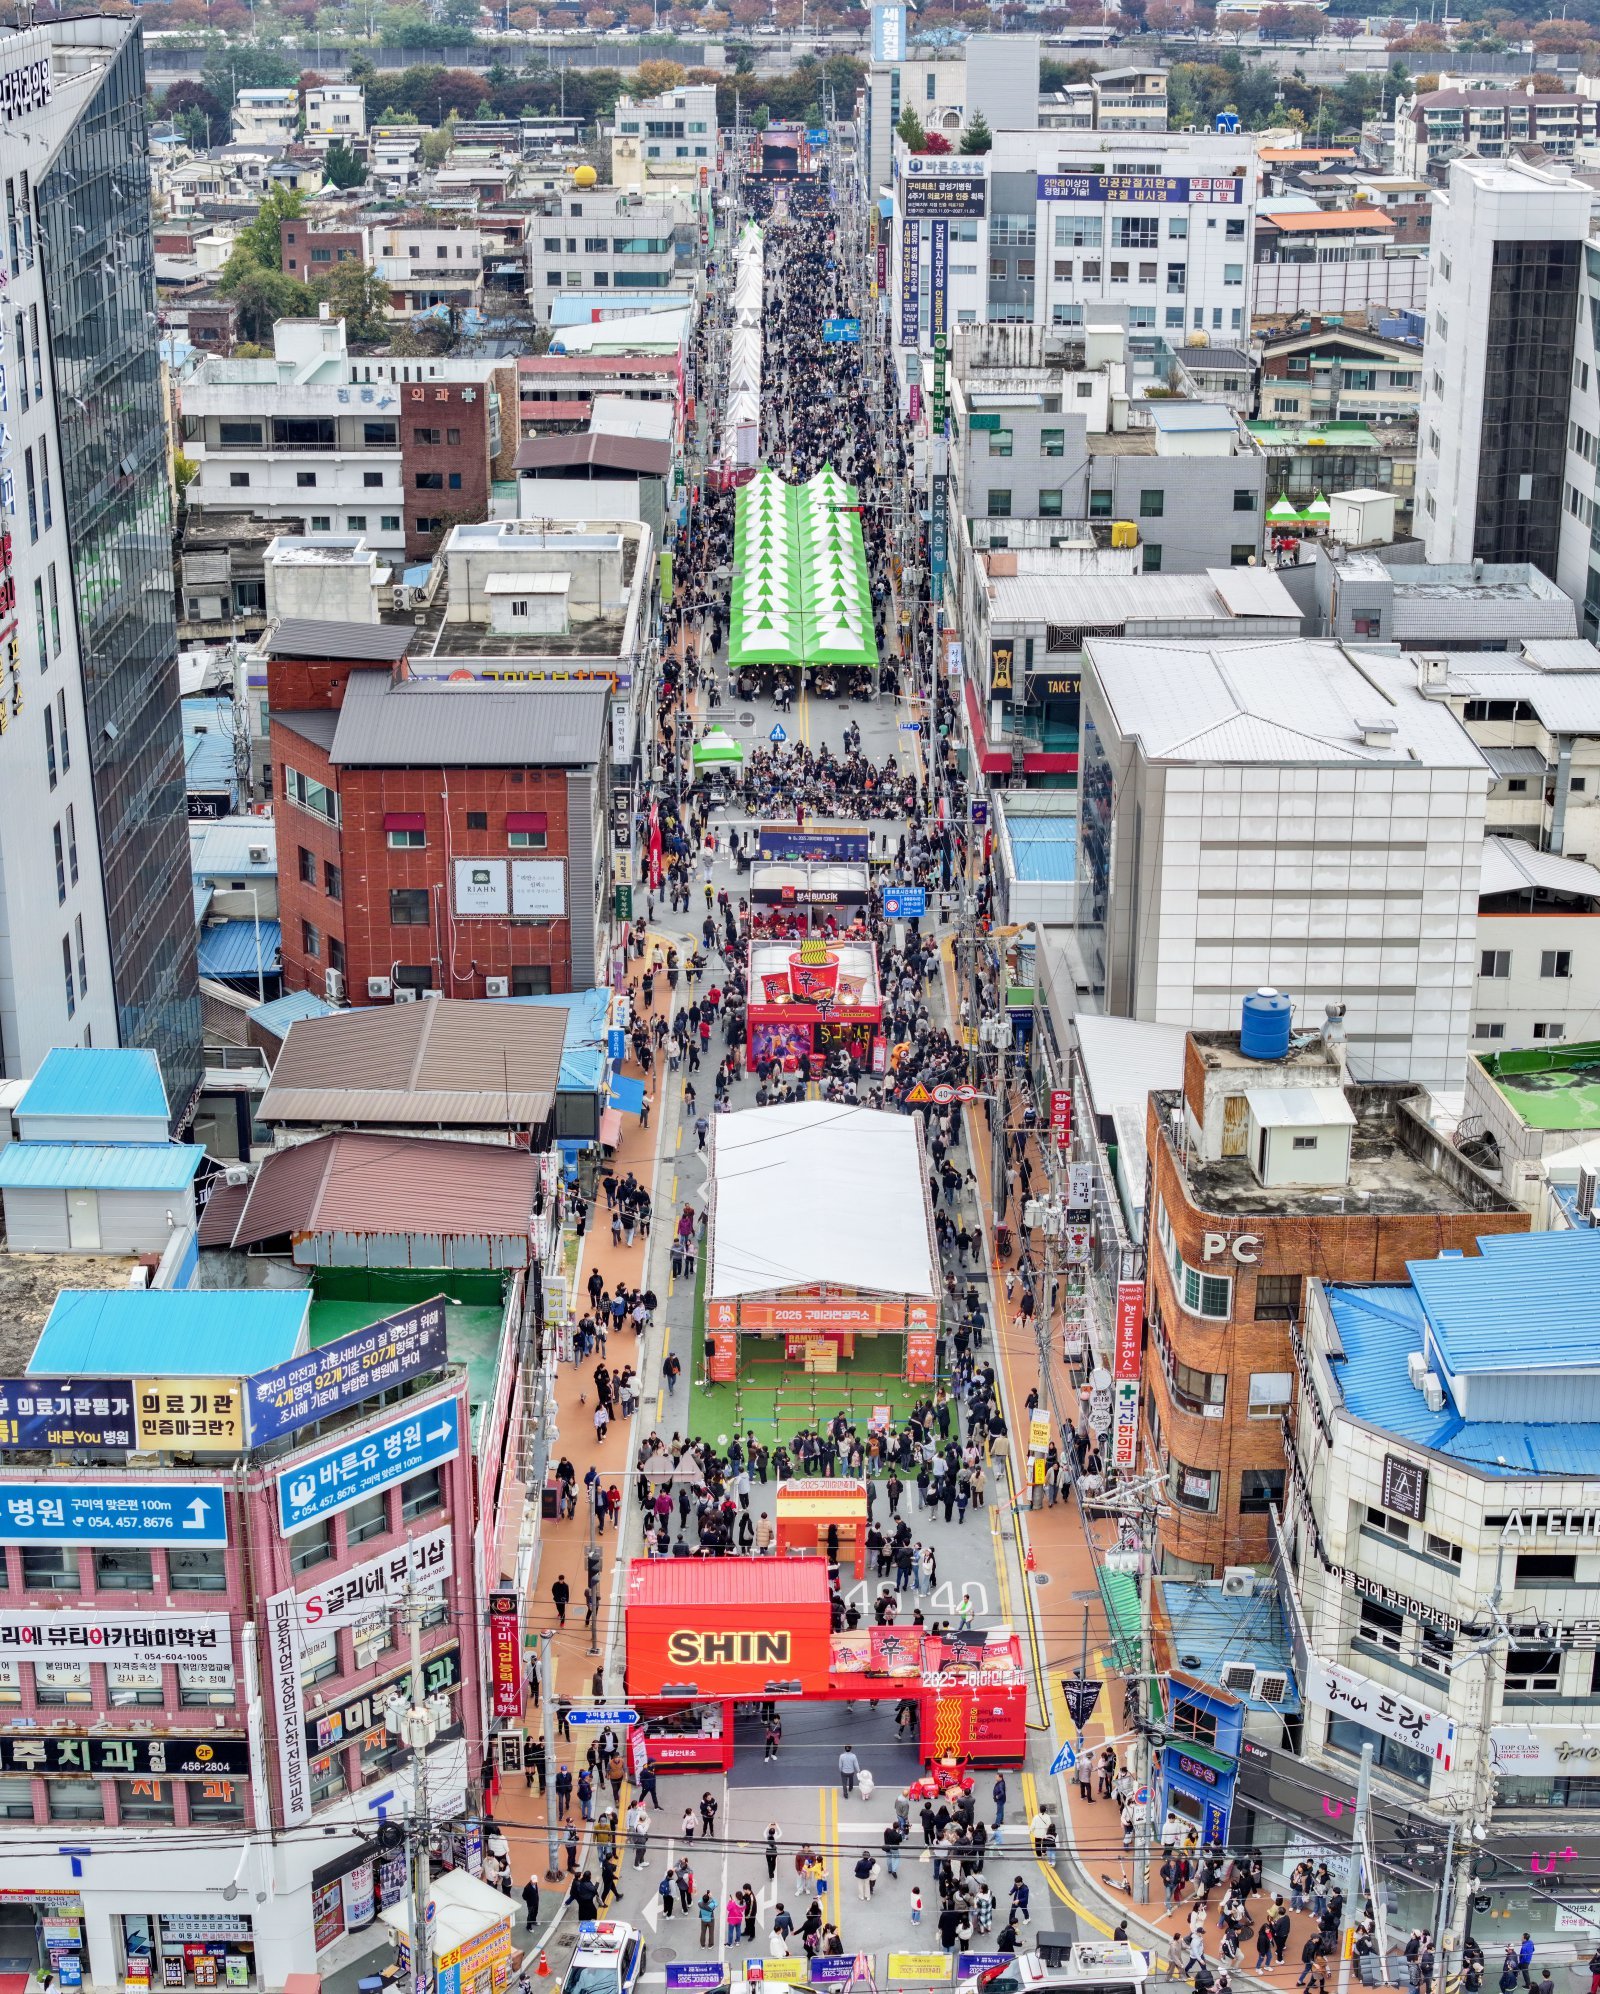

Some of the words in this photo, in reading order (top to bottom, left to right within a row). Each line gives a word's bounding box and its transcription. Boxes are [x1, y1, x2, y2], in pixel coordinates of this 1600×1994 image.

[934, 481, 945, 561] 라온저축은행
[1048, 681, 1070, 693] TAKE
[617, 795, 629, 843] 금오당
[938, 1090, 948, 1098] 40
[1204, 1233, 1259, 1263] PC
[776, 1311, 802, 1320] 2025
[1123, 1304, 1136, 1370] 핸드폰케이스
[289, 1363, 317, 1387] 안전과
[378, 1333, 388, 1348] 질
[420, 1310, 439, 1329] 위해
[280, 1402, 308, 1424] 조사해
[311, 1389, 339, 1411] 기준에
[341, 1373, 369, 1395] 부합한
[371, 1360, 399, 1382] 병원에
[401, 1351, 420, 1368] 부여
[18, 1398, 129, 1416] 의료기관평가
[142, 1420, 235, 1436] 인증마크란?
[48, 1431, 101, 1444] 바른You
[103, 1430, 129, 1445] 병원
[320, 1443, 379, 1486] 바른유
[383, 1422, 422, 1459] 병원
[360, 1472, 380, 1489] 구미역
[404, 1456, 422, 1469] 100m
[801, 1481, 819, 1489] 2025
[8, 1499, 65, 1527] 병원
[70, 1499, 103, 1511] 구미역
[106, 1499, 139, 1511] 맞은편
[141, 1501, 171, 1510] 100m
[48, 1627, 217, 1647] 뷰티아카데미학원
[668, 1630, 791, 1665] SHIN
[880, 1635, 905, 1667] 辛
[144, 1653, 208, 1661] 054-604-1005
[923, 1671, 957, 1687] 2025
[969, 1732, 1002, 1740] Noodles
[198, 1748, 211, 1757] 2F
[181, 1762, 230, 1772] 456-2804
[441, 1951, 459, 1970] 도장
